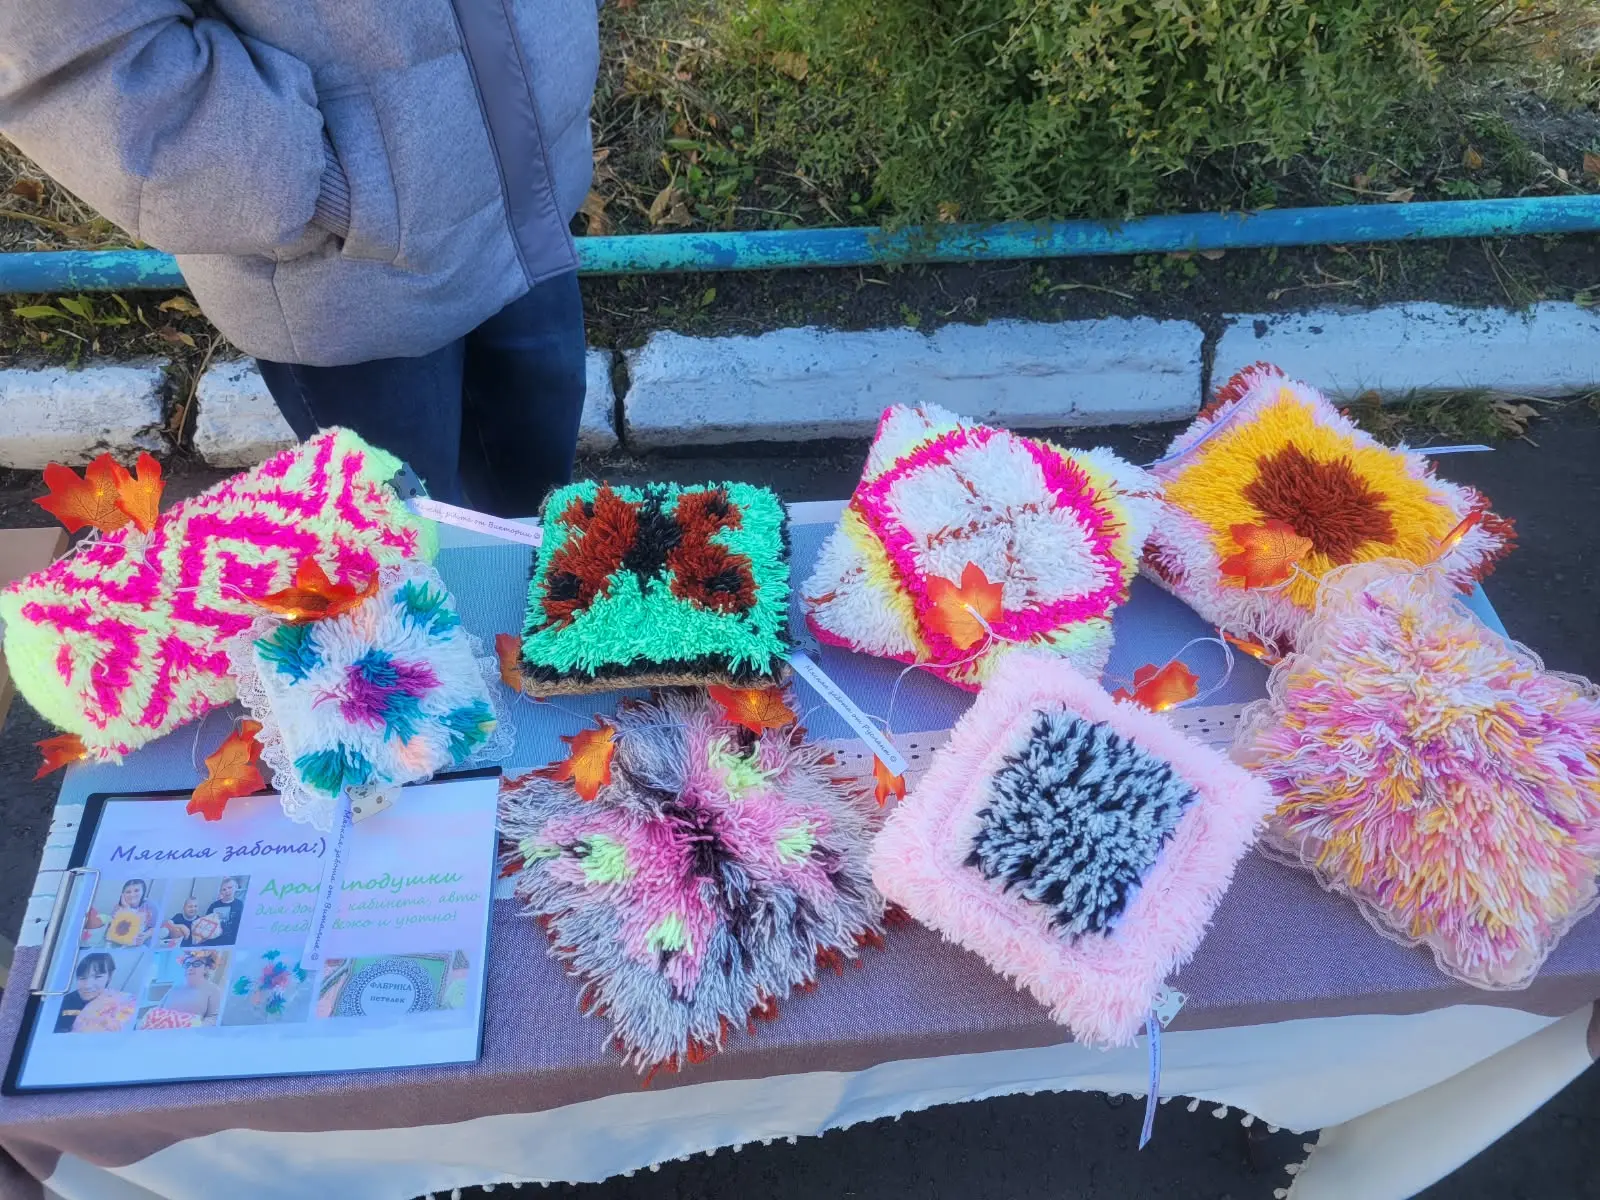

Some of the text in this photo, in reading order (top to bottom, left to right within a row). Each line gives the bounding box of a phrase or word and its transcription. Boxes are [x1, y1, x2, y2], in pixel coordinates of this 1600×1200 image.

[488, 520, 532, 538] Виктории
[829, 690, 853, 714] забота
[338, 809, 353, 847] Мягкая
[110, 837, 326, 862] Мягкая забота:)
[331, 848, 341, 883] забота
[326, 885, 334, 900] от
[255, 902, 287, 915] для
[348, 895, 432, 911] кабинета,
[377, 918, 392, 928] и
[395, 910, 457, 929] уютно!
[370, 982, 412, 991] ФАБРИКА
